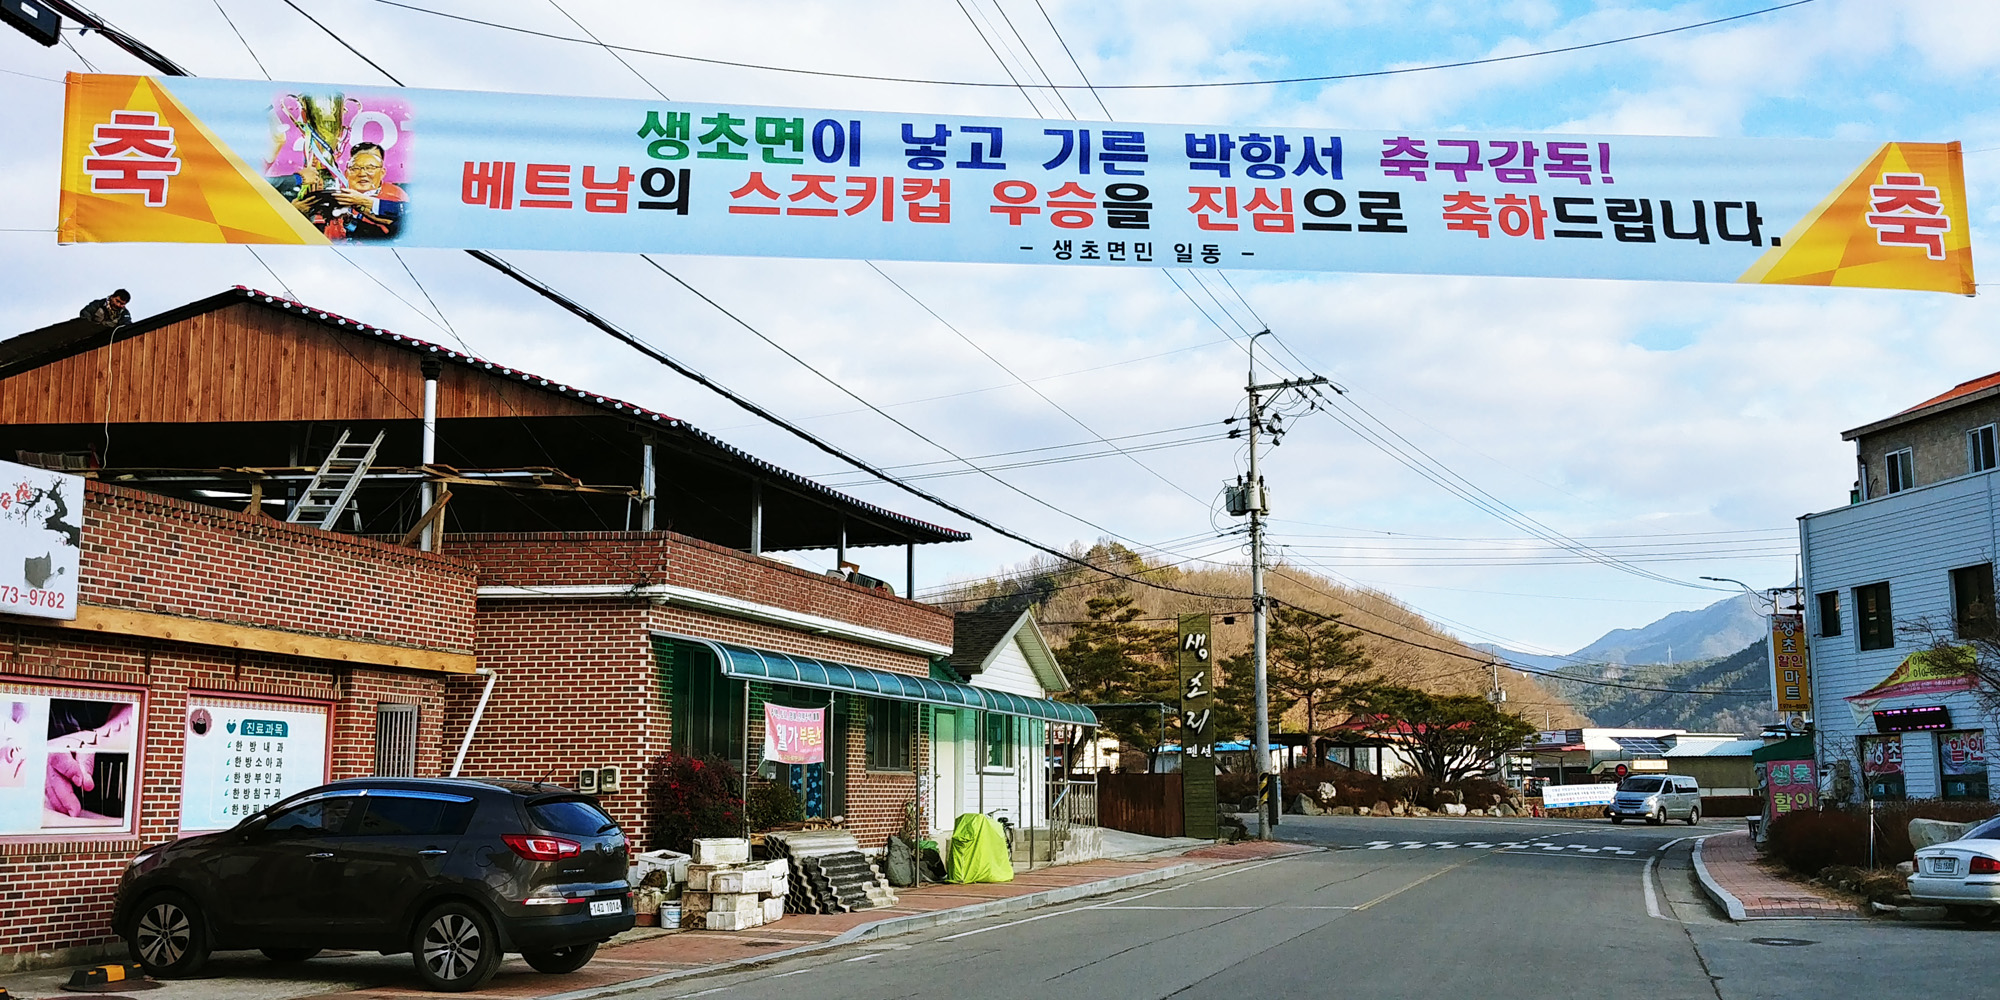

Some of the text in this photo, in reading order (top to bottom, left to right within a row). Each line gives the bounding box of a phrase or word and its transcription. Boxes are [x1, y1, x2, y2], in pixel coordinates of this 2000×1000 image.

[84, 111, 180, 206] 축
[637, 111, 1614, 185] 생초면이 낳고 기른 박항서 축구감독!
[462, 162, 1782, 247] 베트남의 스즈키컵 우승을 진심으로 축하드립니다.
[1866, 172, 1951, 261] 축
[1053, 240, 1221, 264] 생초면민 일동
[1, 586, 65, 608] 73-9782
[1778, 655, 1803, 668] 할인
[246, 722, 283, 736] 진료과목
[1186, 743, 1211, 758] 펜션
